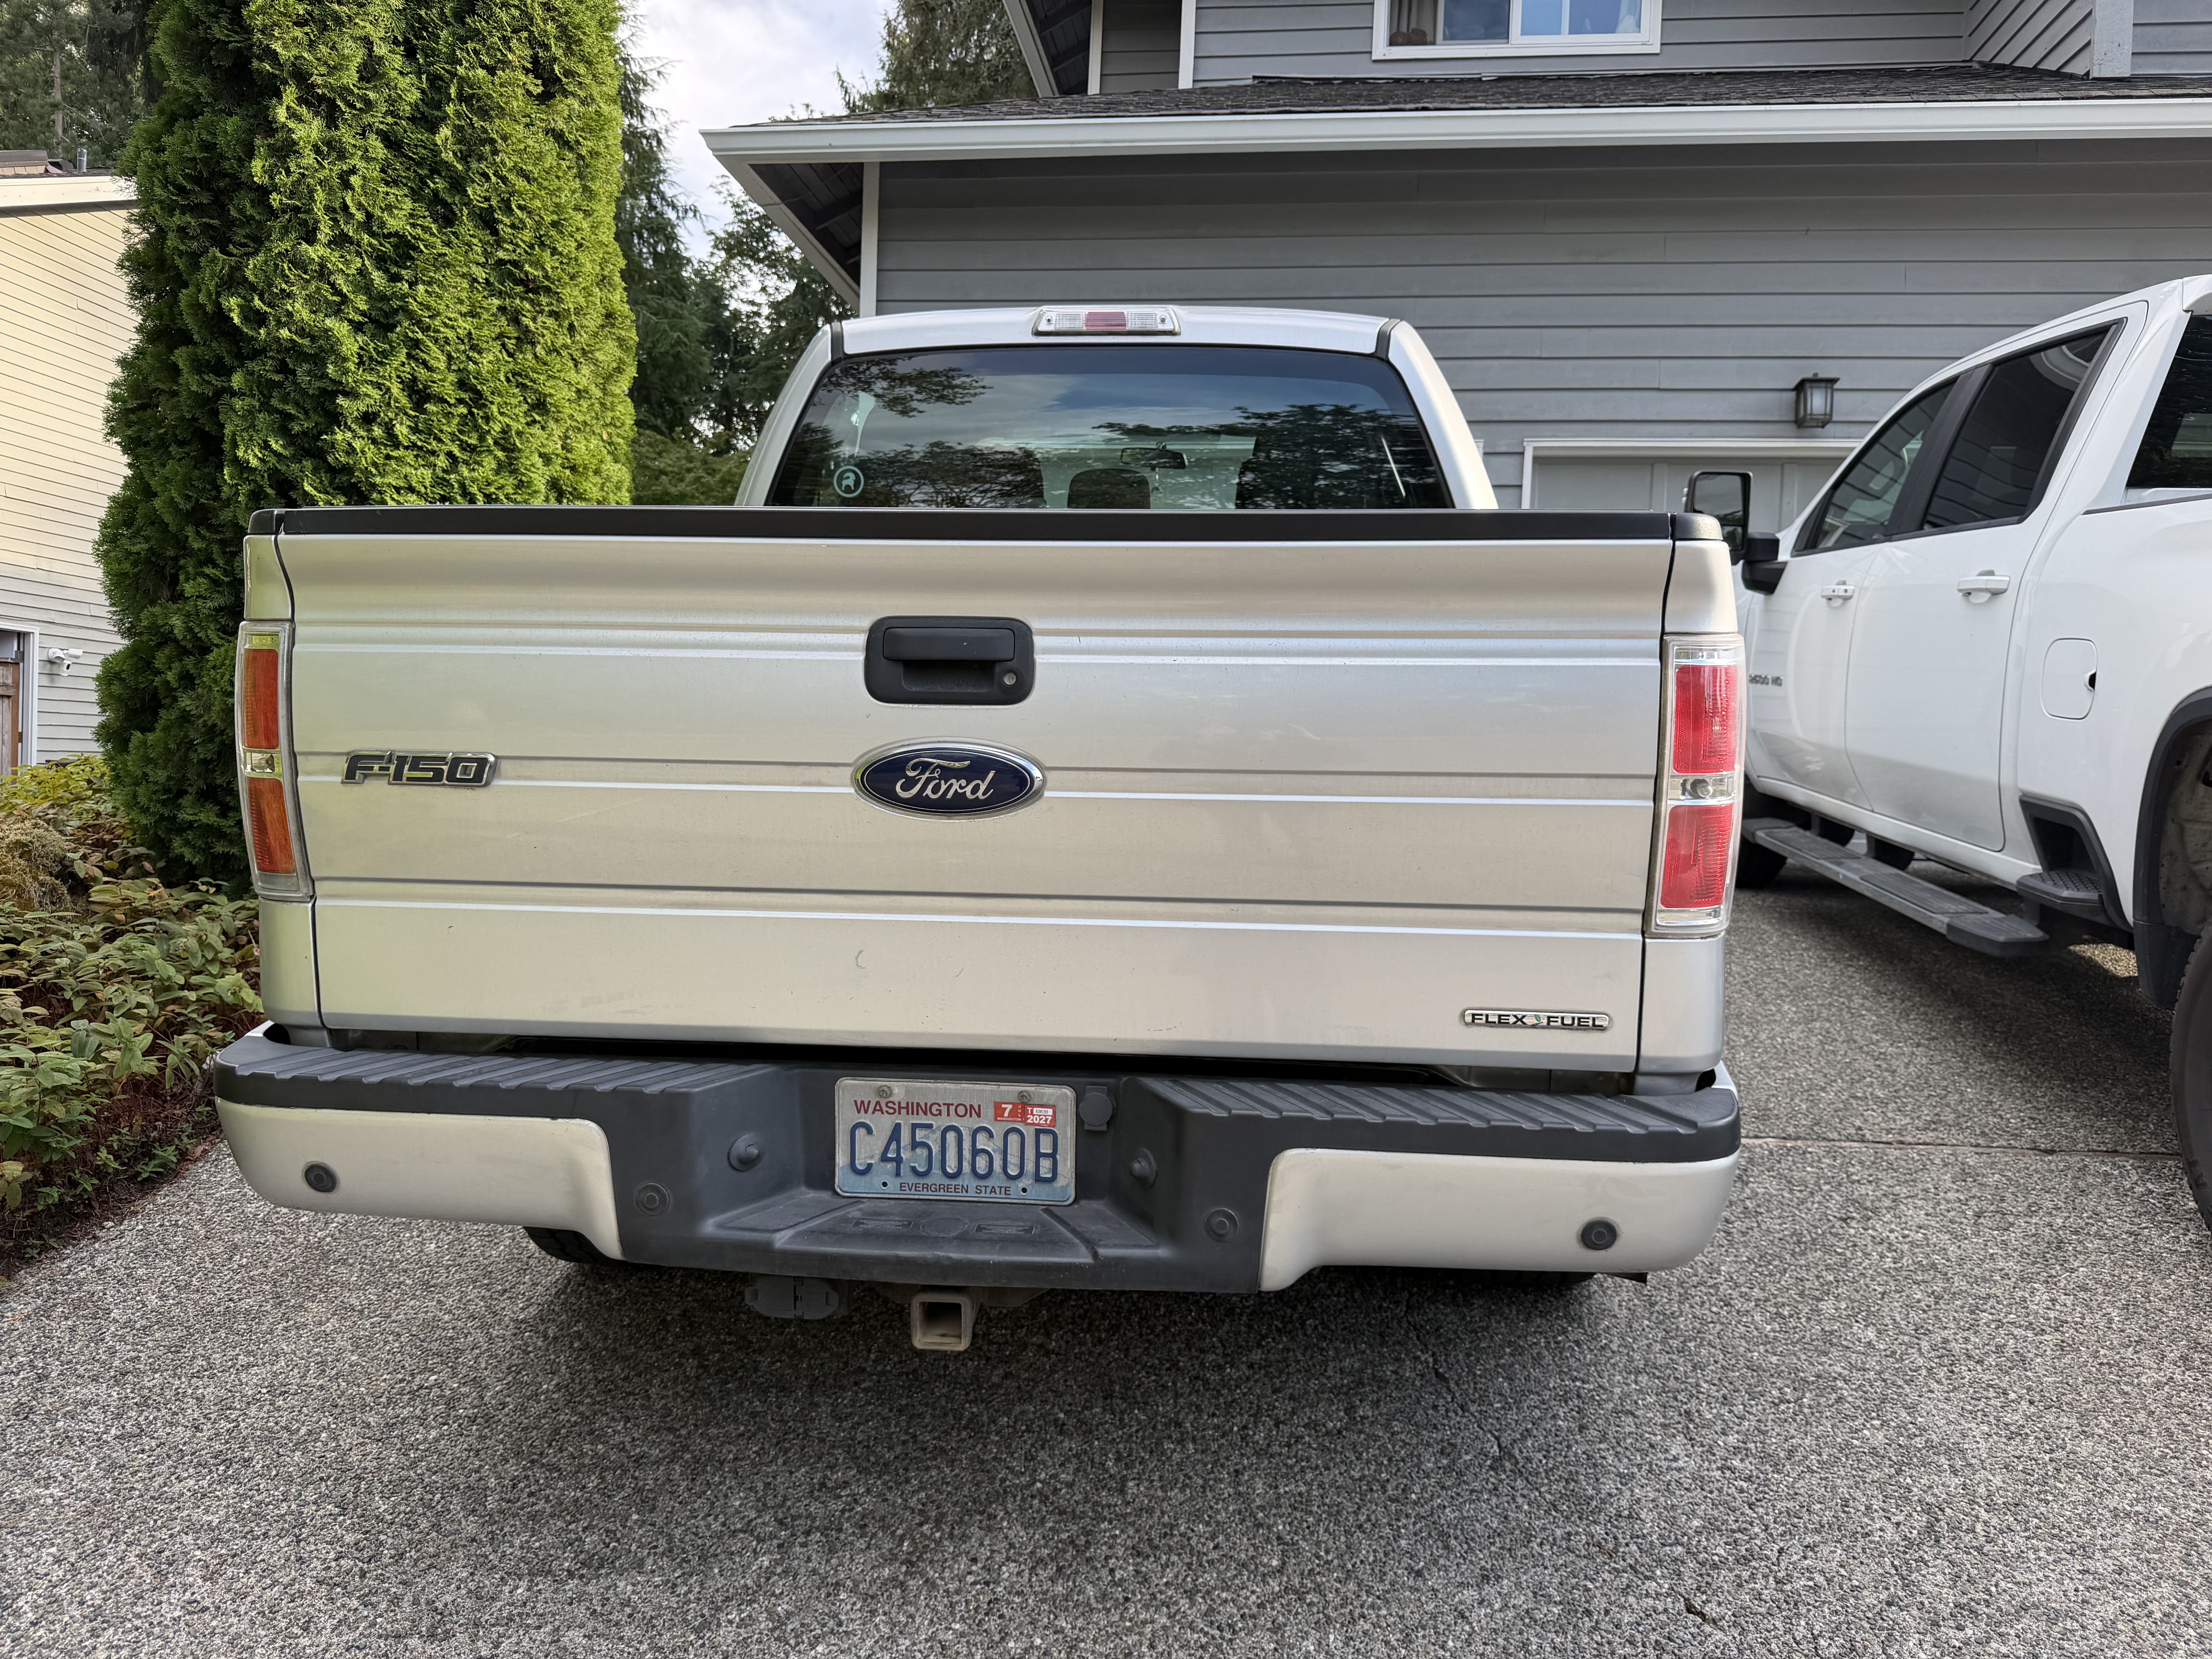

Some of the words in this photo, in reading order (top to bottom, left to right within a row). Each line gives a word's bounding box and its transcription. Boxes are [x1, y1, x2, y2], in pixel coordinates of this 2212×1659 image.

[341, 750, 496, 787] F-150
[896, 758, 996, 800] Ford
[1472, 1013, 1527, 1025] FLEX
[1547, 1016, 1603, 1027] FUEL
[854, 1100, 981, 1118] WASHINGTON
[1002, 1104, 1012, 1117] 7
[1027, 1115, 1052, 1124] 2027
[850, 1121, 1058, 1183] C45060B
[900, 1182, 969, 1194] EVERGREEN
[975, 1185, 1011, 1195] STATE
